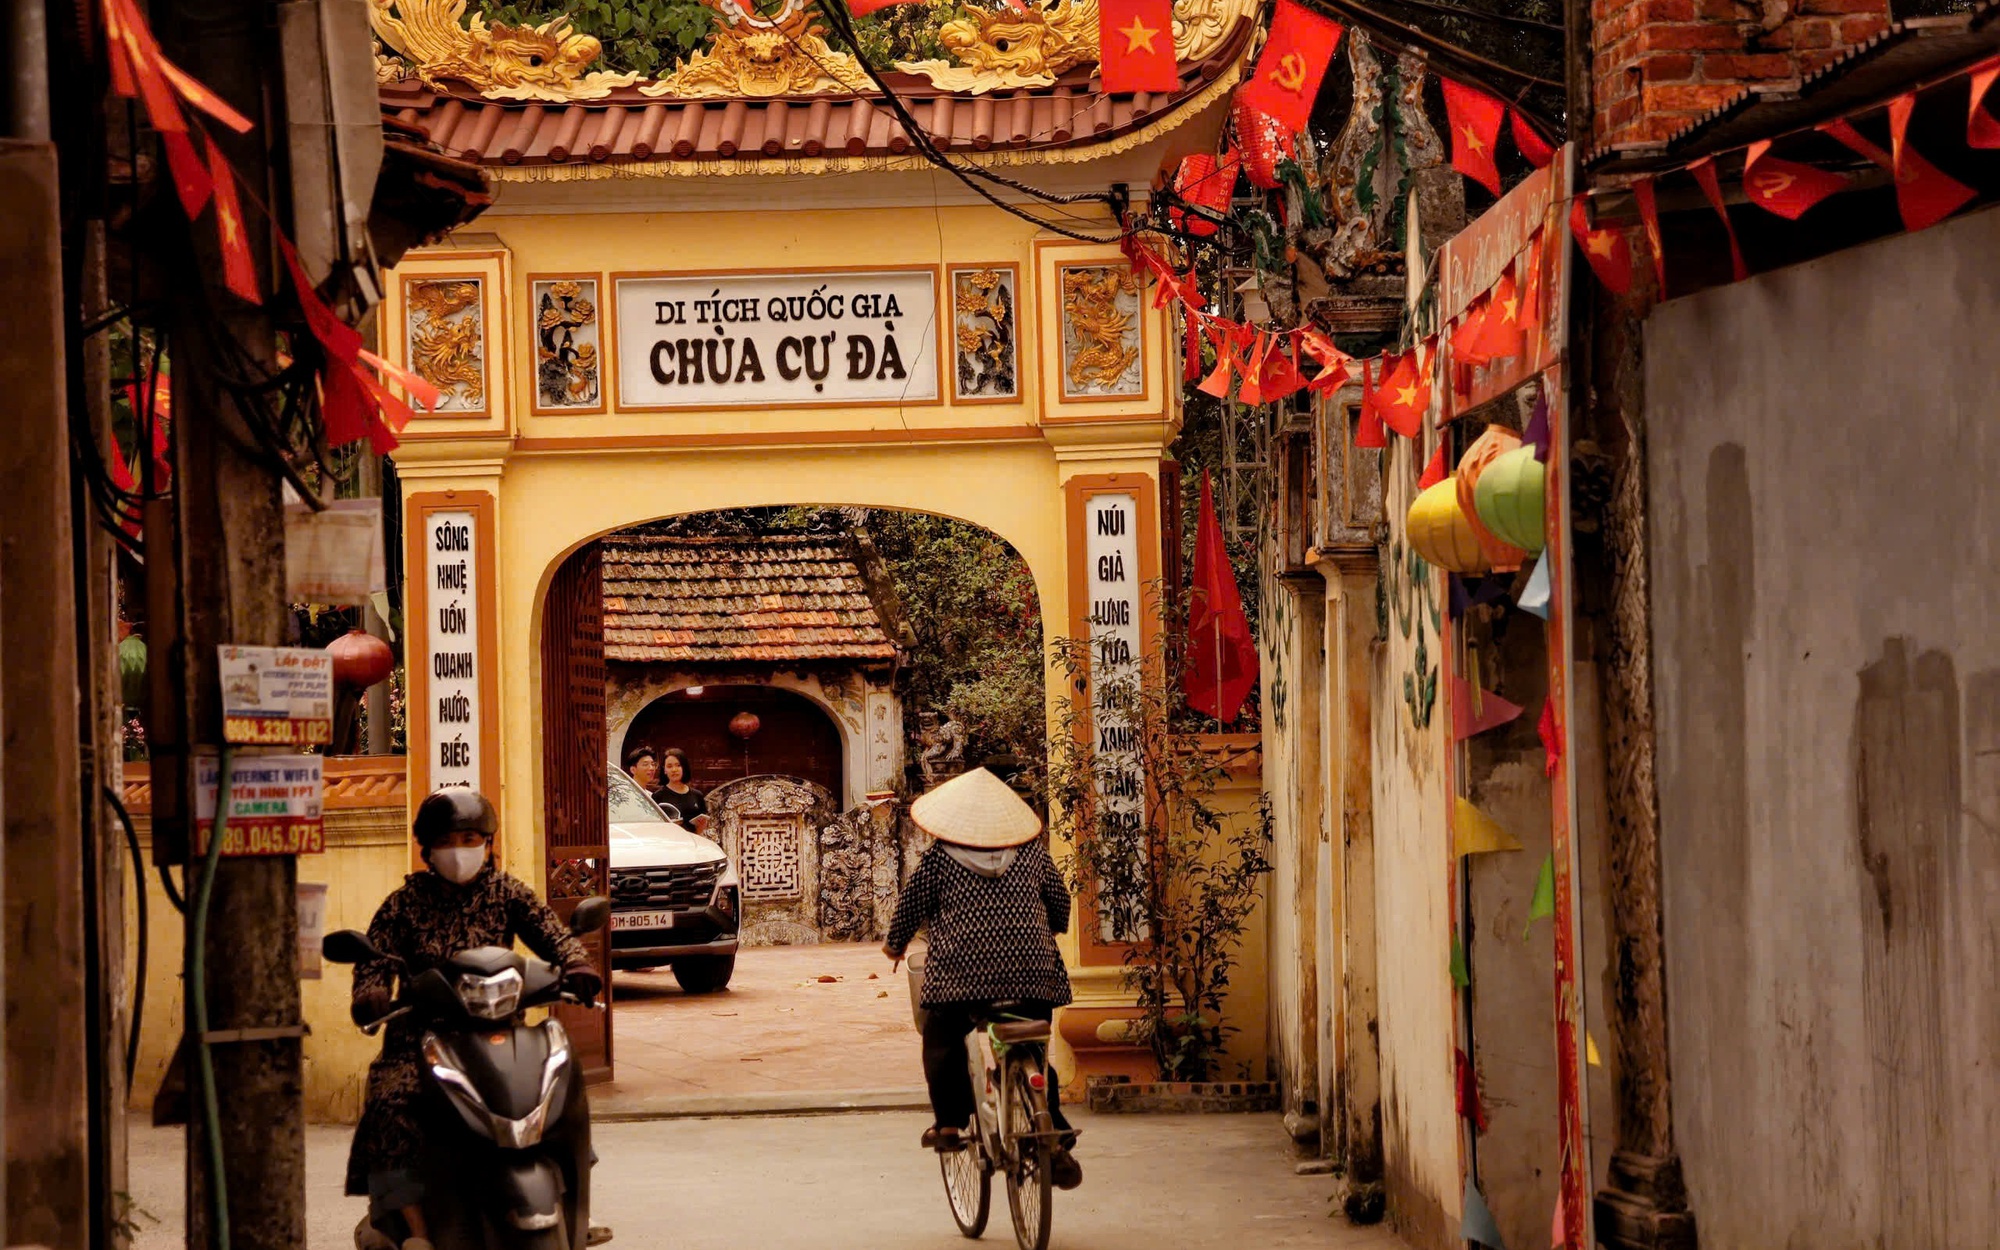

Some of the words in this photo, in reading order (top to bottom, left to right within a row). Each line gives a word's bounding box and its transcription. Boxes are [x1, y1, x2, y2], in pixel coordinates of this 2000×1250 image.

[655, 300, 686, 325] DI
[694, 288, 760, 323] TÍCH
[767, 284, 844, 323] QUỐC
[851, 293, 903, 318] GIA
[649, 325, 766, 385] CHÙA
[776, 330, 836, 393] CỰ
[846, 320, 907, 380] ĐÀ
[435, 520, 469, 552] SÔNG
[1097, 504, 1125, 536] NÚI
[437, 560, 467, 594] NHUỆ
[1098, 550, 1125, 582] GIÀ
[440, 599, 466, 634] UỐN
[1094, 597, 1130, 626] LƯNG
[434, 652, 473, 679] QUANH
[439, 690, 470, 724] NƯỚC
[440, 733, 470, 768] BIẾC
[1100, 726, 1136, 752] XANH
[284, 769, 309, 782] WIFI
[312, 768, 319, 781] 6
[293, 785, 314, 798] FPT
[235, 802, 288, 814] CAMERA
[200, 825, 322, 856] 089.045.975
